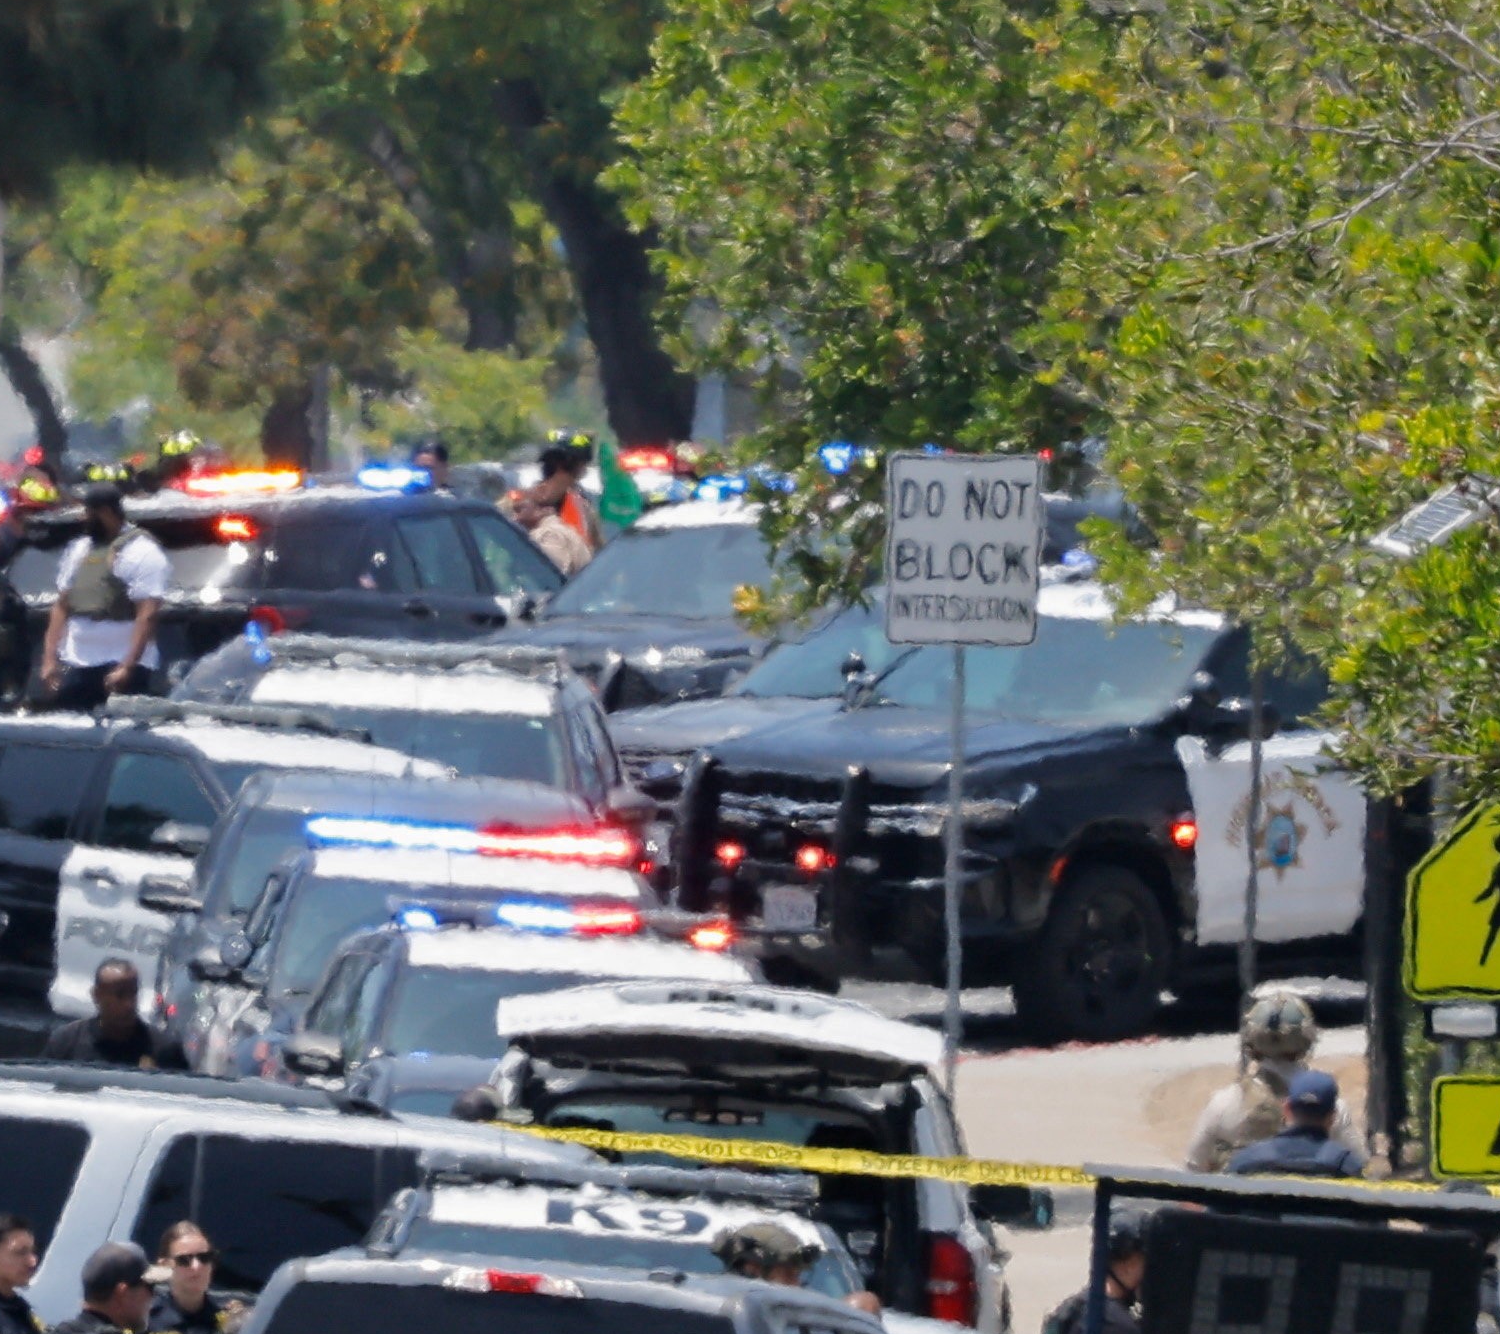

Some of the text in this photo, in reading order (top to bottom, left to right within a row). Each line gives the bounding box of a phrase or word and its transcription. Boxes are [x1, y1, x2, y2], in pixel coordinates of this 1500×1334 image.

[899, 479, 1032, 520] DO NOT
[895, 539, 1031, 585] BLOCK
[894, 593, 1030, 624] INTERSECTION
[547, 1200, 709, 1236] K9
